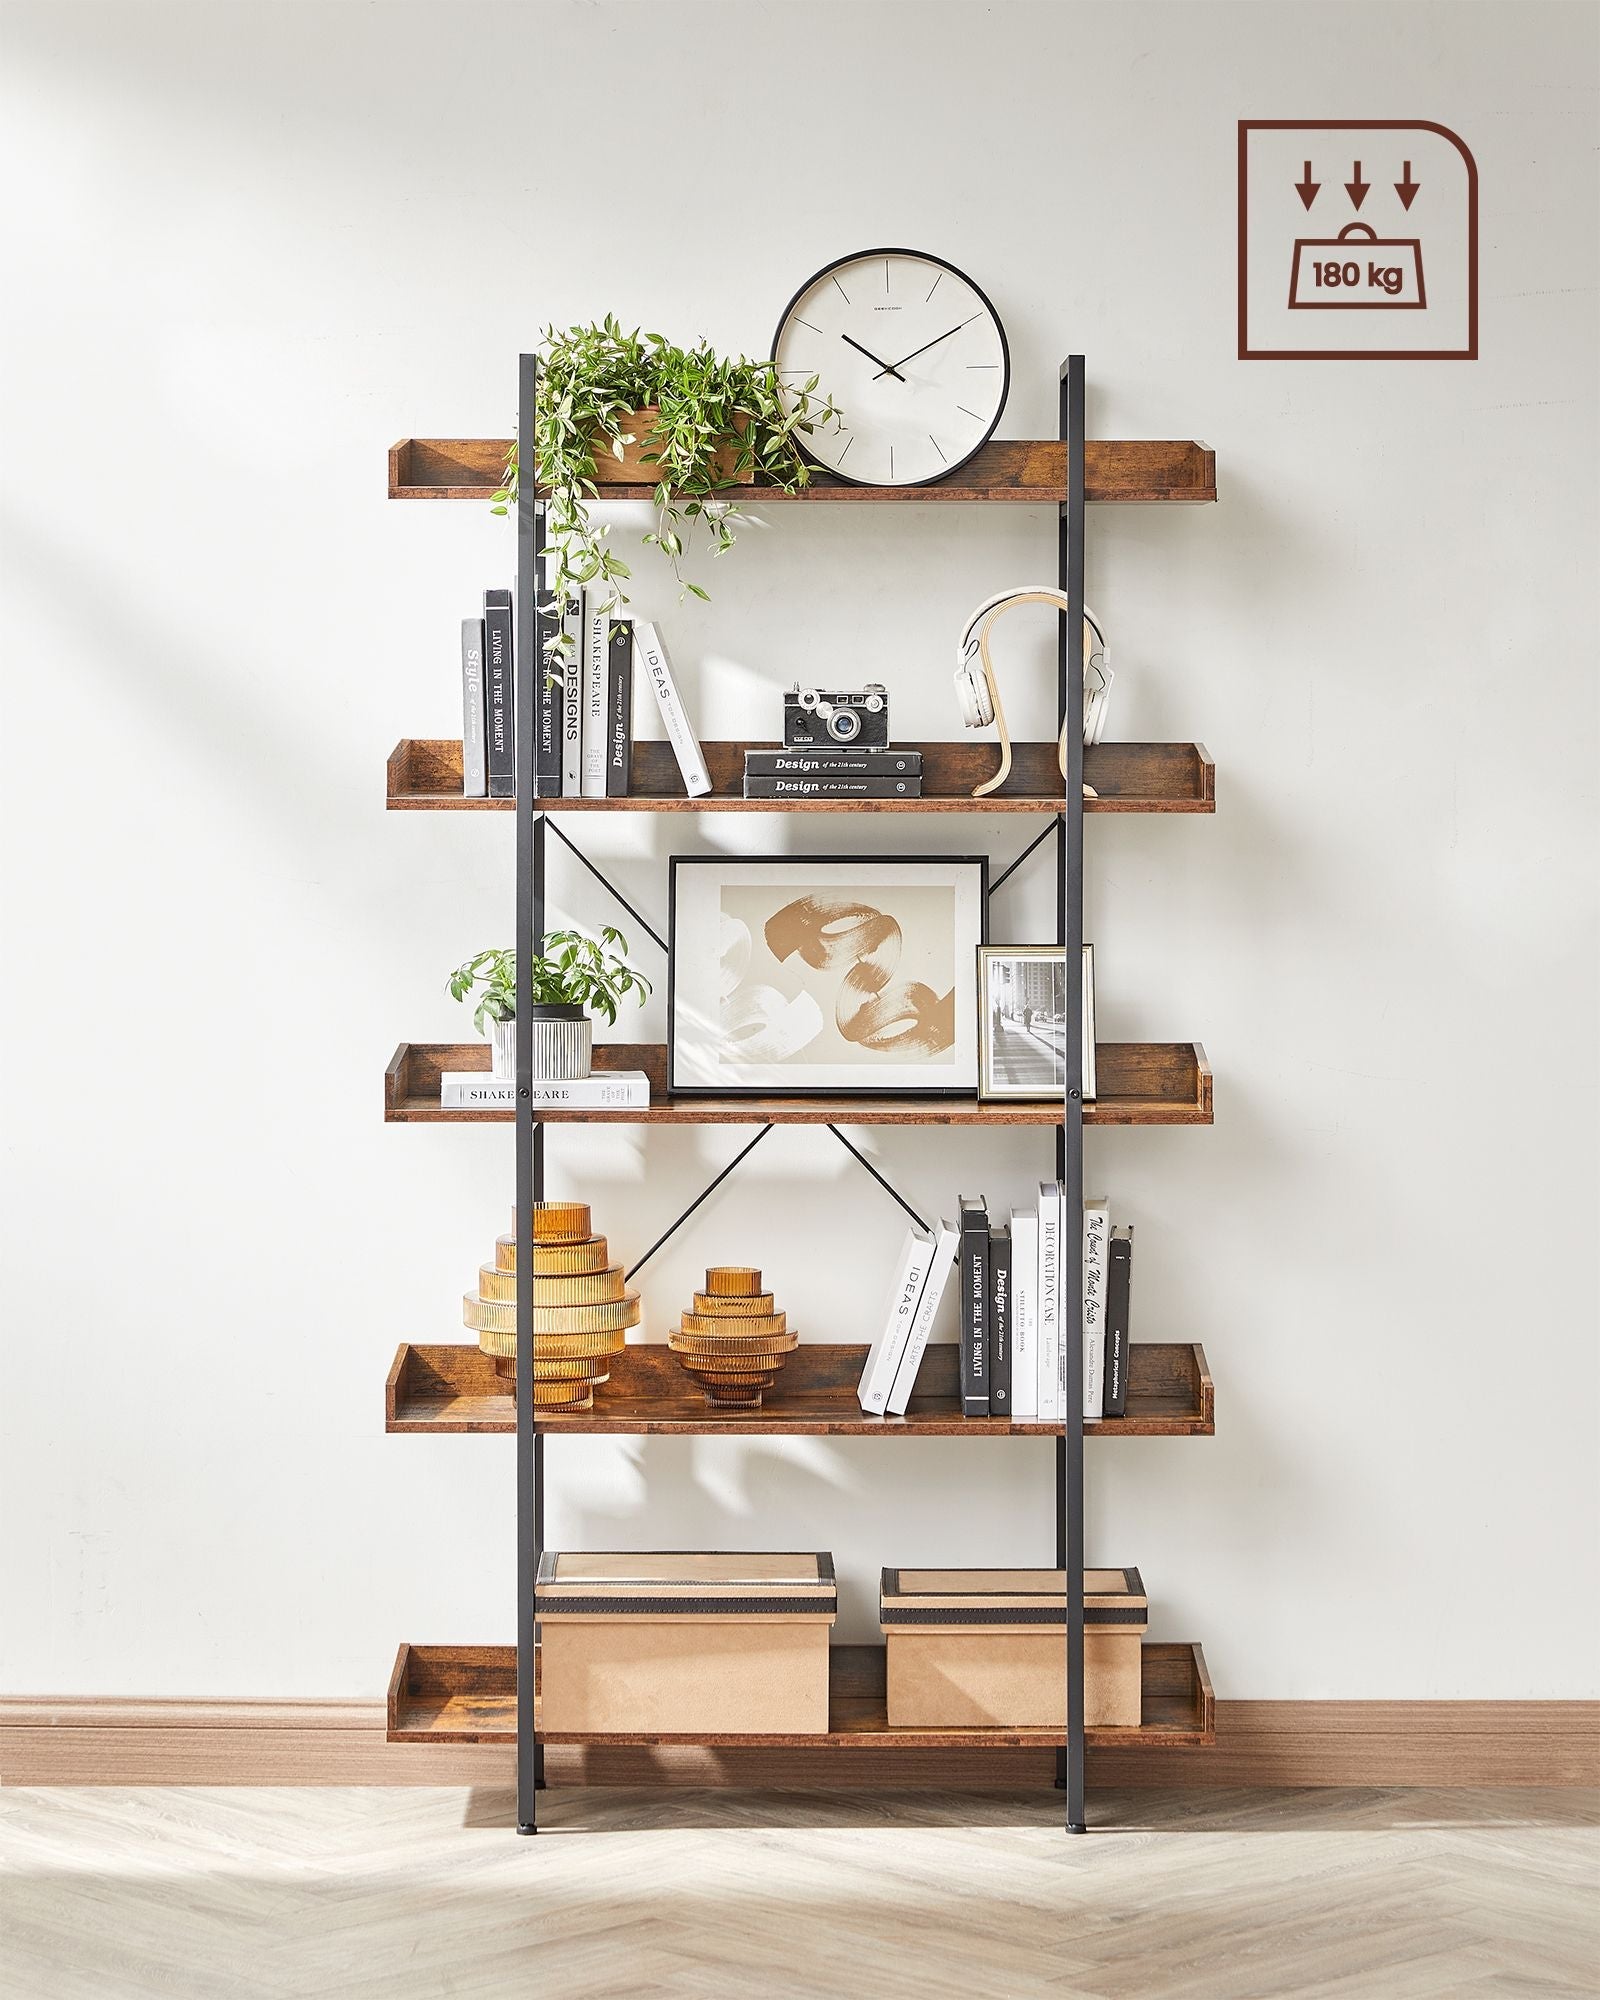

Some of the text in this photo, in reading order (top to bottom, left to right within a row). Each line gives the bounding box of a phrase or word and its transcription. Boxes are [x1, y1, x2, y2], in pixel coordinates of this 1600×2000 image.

[466, 650, 479, 692] Style
[492, 630, 504, 752] LIVING IN THE MOMENT
[592, 618, 602, 718] SHAKESPEARE
[647, 650, 670, 699] IDEAS
[567, 664, 578, 741] DESIGNS
[542, 710, 552, 753] MOMENT
[613, 723, 626, 767] Design
[775, 759, 820, 771] Design
[775, 781, 820, 793] Design
[470, 1090, 569, 1099] SHAKEEARE
[900, 1267, 920, 1314] IDEAS
[994, 1269, 1007, 1313] Design
[1044, 1222, 1055, 1325] DECORATION CASE
[1085, 1216, 1103, 1325] The Count of Monte Cristo
[909, 1291, 938, 1366] ARTS THE CRAFTS
[973, 1254, 982, 1377] LIVING IN THE MOMENT
[1088, 1338, 1096, 1368] Alexandre
